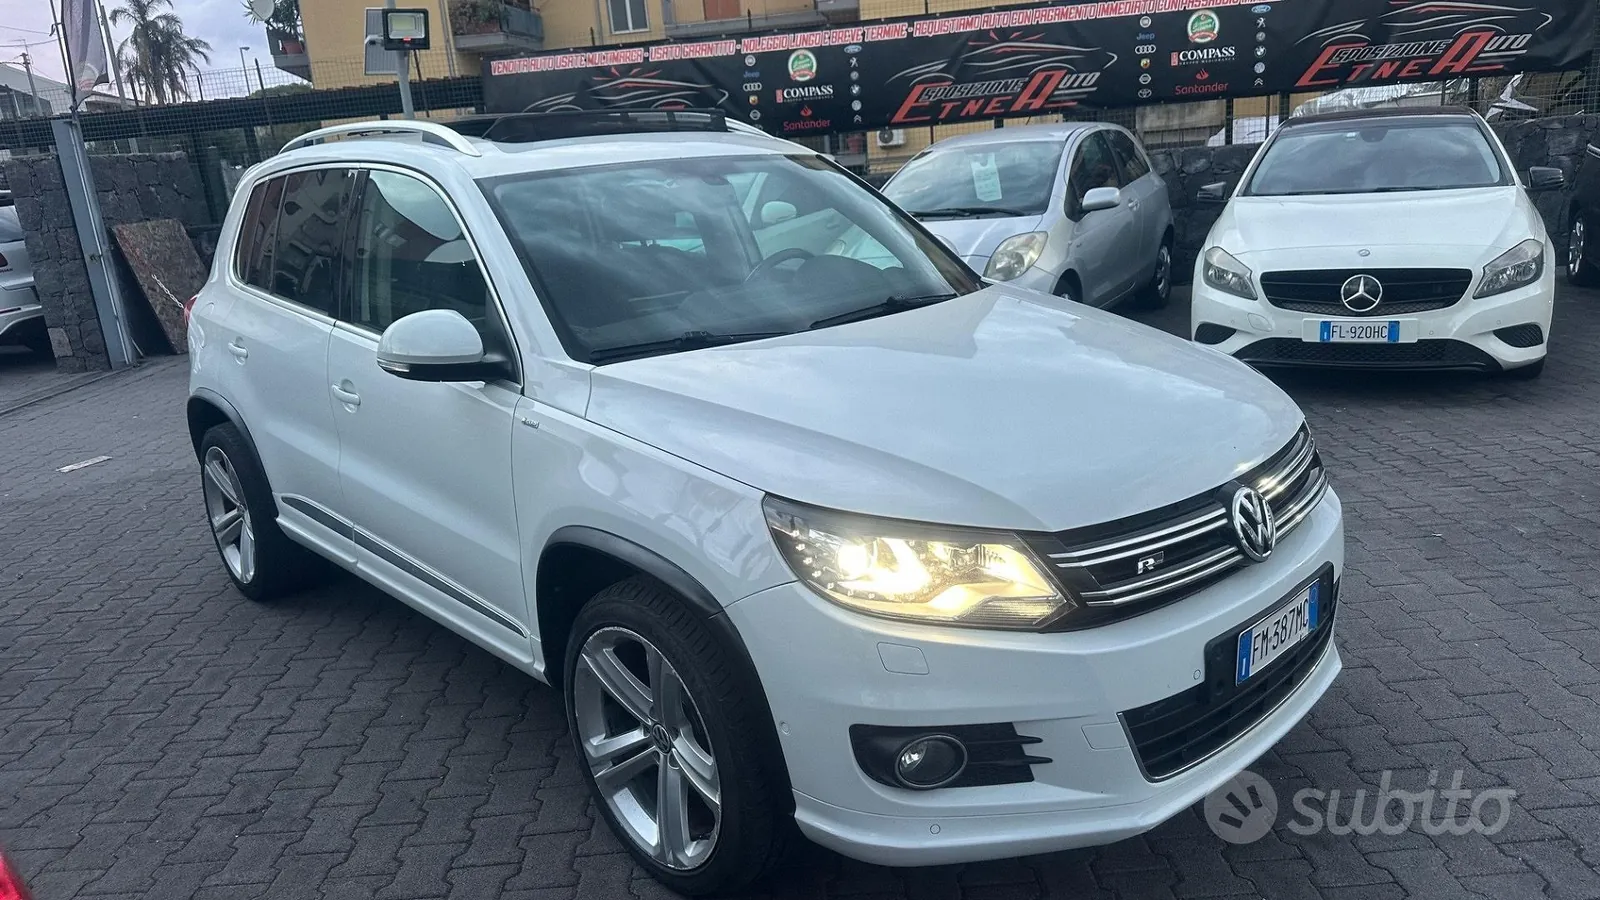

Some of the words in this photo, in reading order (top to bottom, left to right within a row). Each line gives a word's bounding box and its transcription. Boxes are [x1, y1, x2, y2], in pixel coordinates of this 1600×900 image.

[491, 58, 528, 75] VENDITA
[529, 56, 554, 72] AUTO
[554, 53, 586, 70] USATE
[587, 48, 644, 67] MULTIMARCA
[649, 44, 681, 61] USATO
[682, 40, 736, 59] GARANTITO
[741, 34, 788, 54] NOLEGGIO
[789, 31, 821, 50] LUNGO
[821, 30, 830, 46] E
[830, 27, 863, 45] BREVE
[864, 22, 908, 42] TERMINE
[913, 14, 981, 37] ACQUISTIAMO
[981, 11, 1010, 29] AUTO
[1010, 9, 1033, 26] CON
[1033, 3, 1098, 24] PAGAMENTO
[1097, 0, 1156, 18] IMMEDIATO
[1180, 46, 1235, 61] COMPASS
[783, 84, 833, 98] COMPASS
[1175, 82, 1229, 95] Santander
[783, 119, 830, 131] Santander
